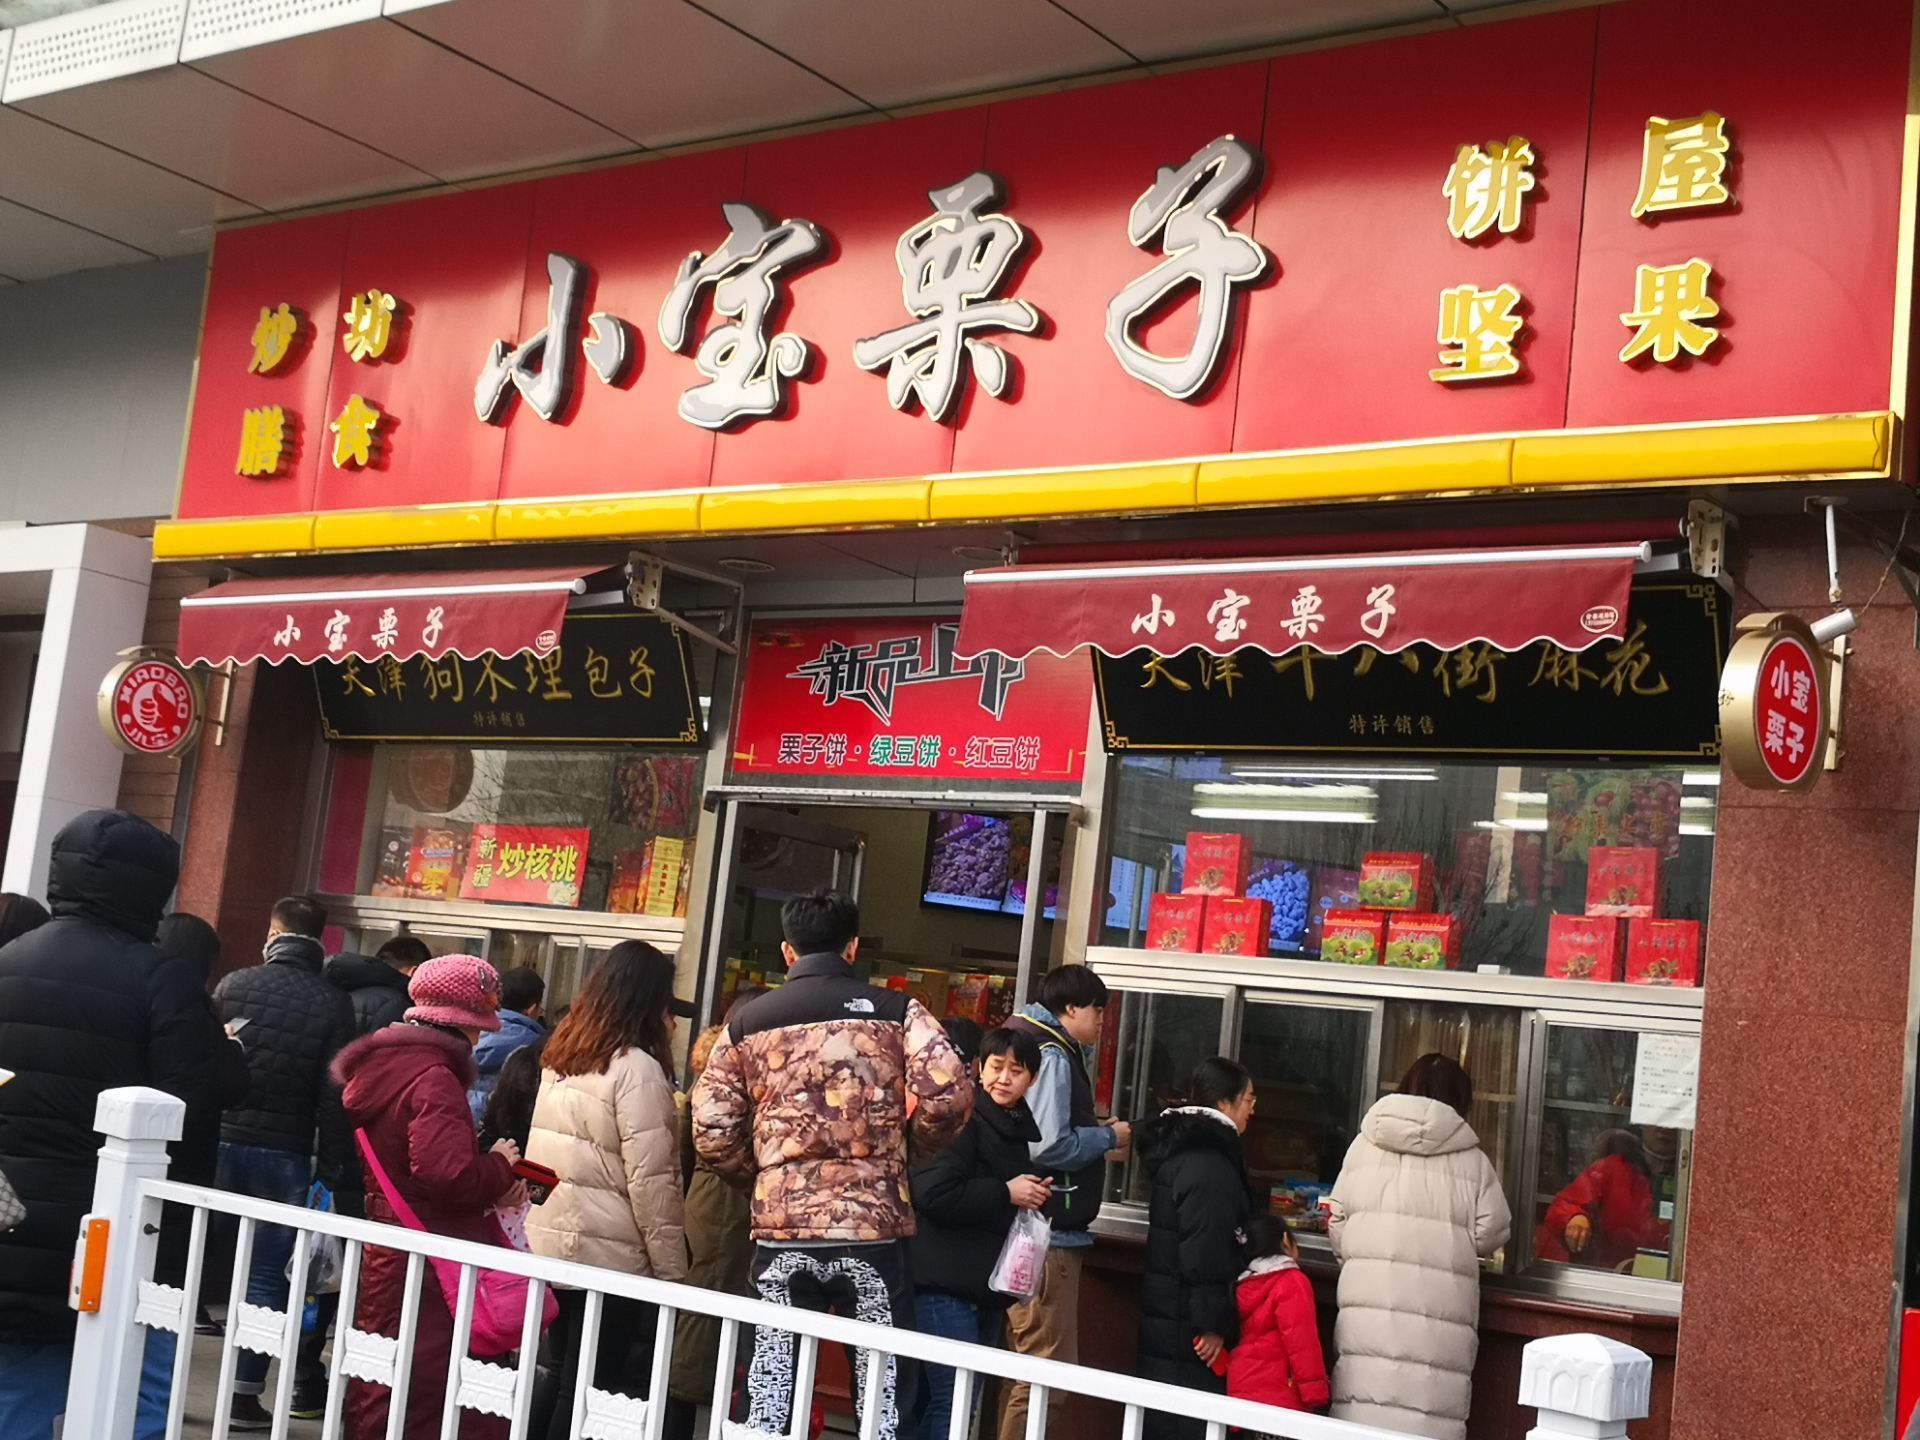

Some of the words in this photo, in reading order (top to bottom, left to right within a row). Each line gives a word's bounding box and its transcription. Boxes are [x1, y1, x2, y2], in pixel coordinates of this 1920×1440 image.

[1443, 113, 1731, 240] 饼屋
[474, 134, 1268, 430] 小宝栗子
[247, 289, 398, 374] 炒坊
[1429, 258, 1721, 384] 坚果
[236, 395, 384, 477] 膳食
[273, 607, 444, 652] 小宝栗子
[1131, 583, 1397, 641] 小宝栗子
[120, 666, 189, 719] XIAOBAO
[1350, 714, 1434, 736] 特许销售
[1765, 709, 1804, 764] 栗子
[471, 836, 497, 888] 新疆
[496, 841, 578, 882] 炒核桃
